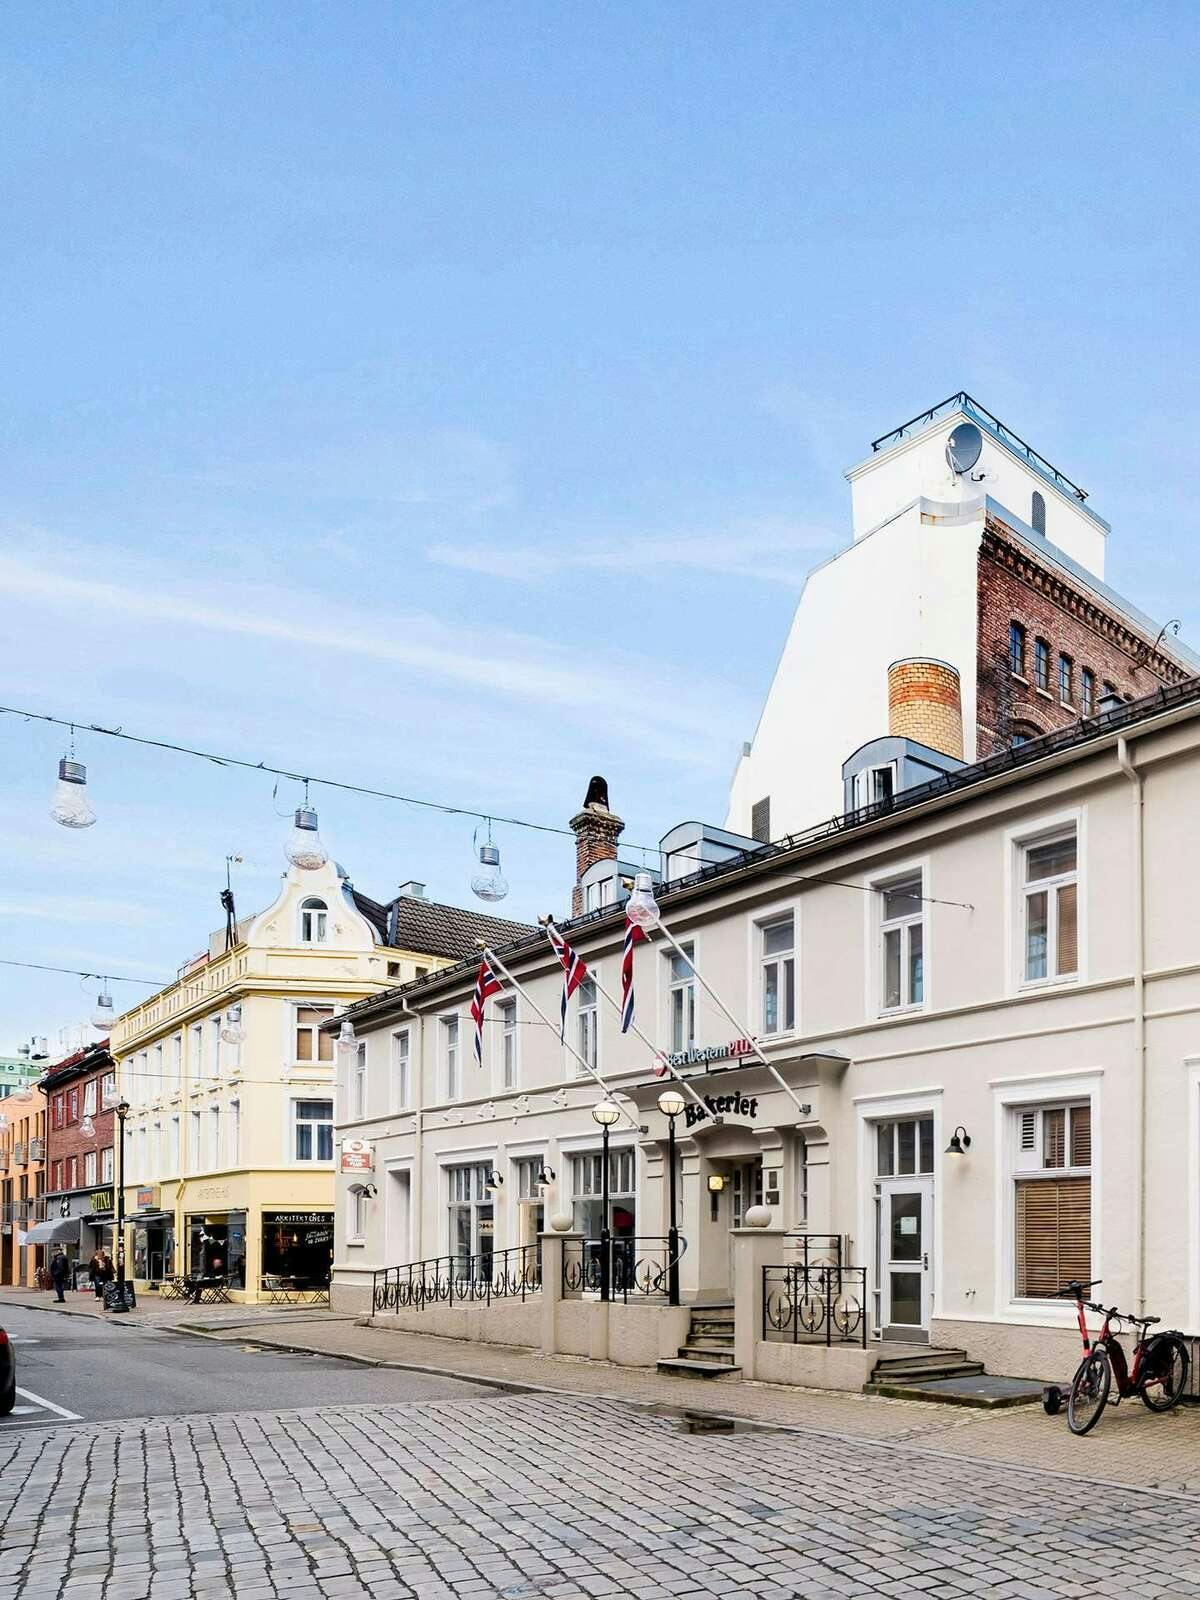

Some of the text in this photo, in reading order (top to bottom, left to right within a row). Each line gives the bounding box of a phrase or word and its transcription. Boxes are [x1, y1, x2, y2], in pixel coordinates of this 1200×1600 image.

[668, 1050, 686, 1066] Best
[687, 1046, 726, 1062] Western
[685, 1091, 758, 1128] Bakeriet
